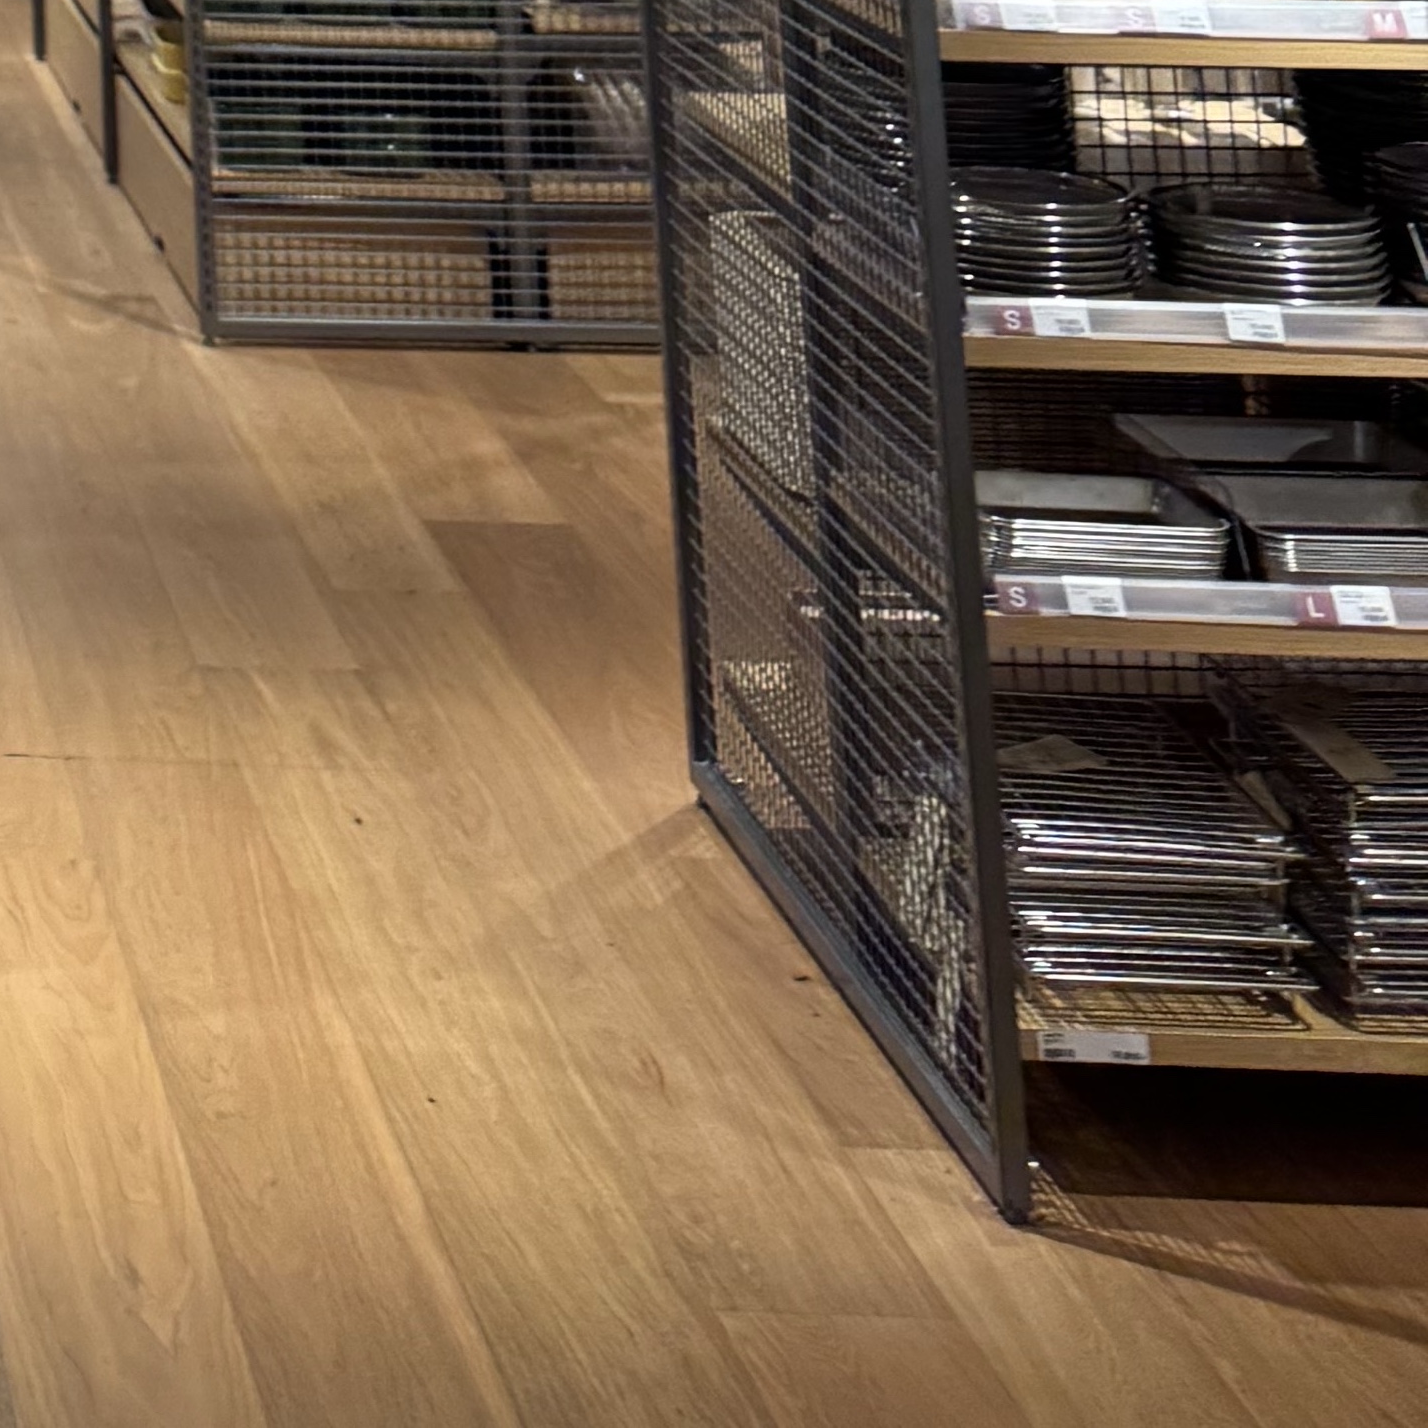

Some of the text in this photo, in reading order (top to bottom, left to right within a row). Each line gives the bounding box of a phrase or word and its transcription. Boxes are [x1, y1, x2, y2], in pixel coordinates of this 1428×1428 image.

[1372, 12, 1399, 33] M
[1002, 309, 1021, 330] S
[1008, 586, 1028, 608] S
[1307, 596, 1326, 618] L
